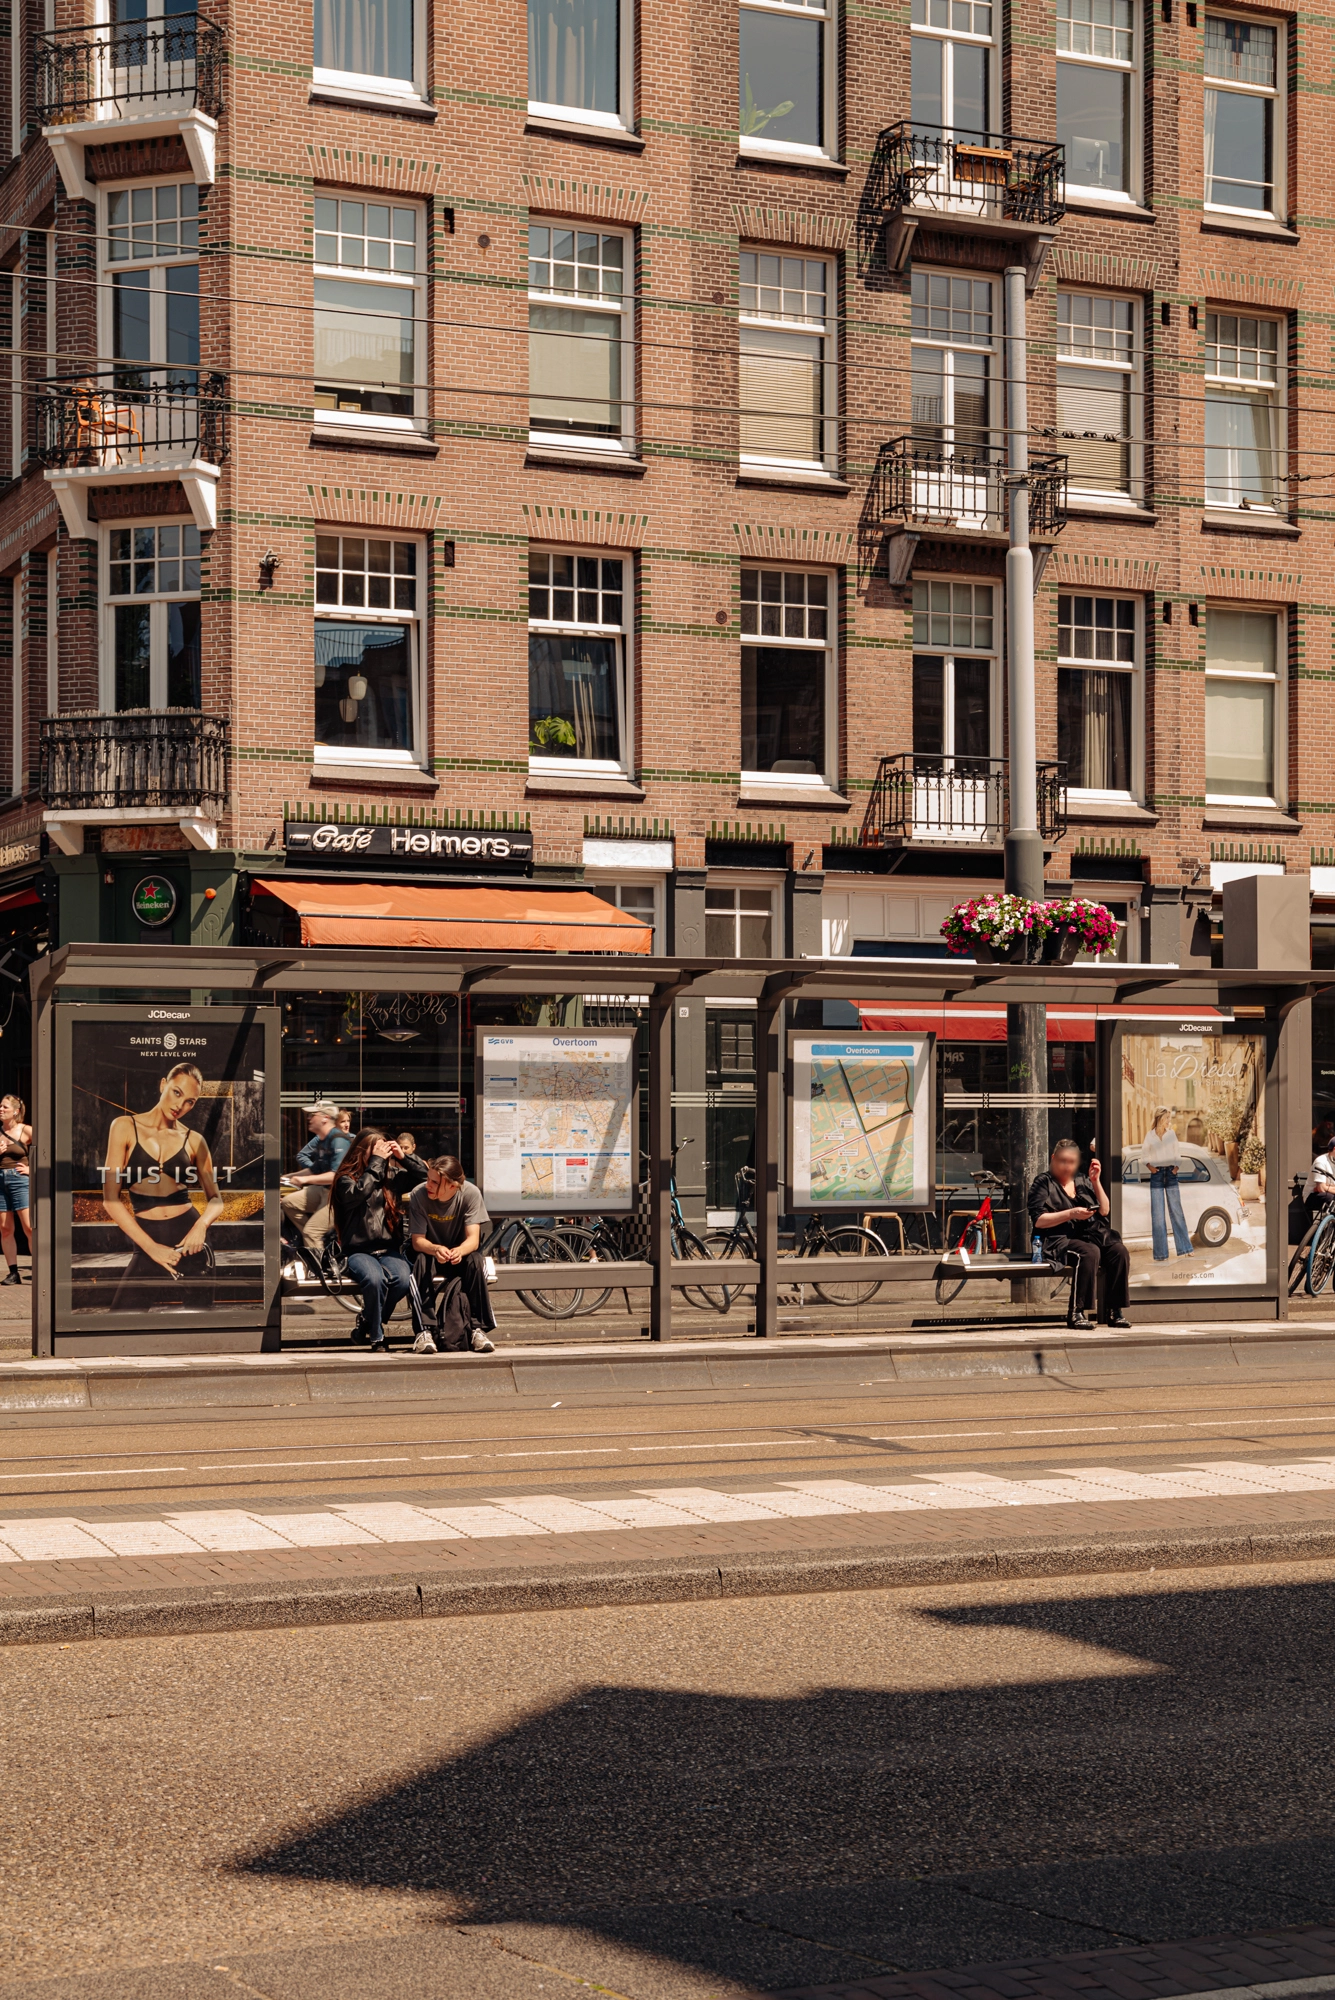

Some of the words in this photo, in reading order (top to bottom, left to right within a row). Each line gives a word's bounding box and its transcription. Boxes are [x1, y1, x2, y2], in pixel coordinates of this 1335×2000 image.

[312, 825, 376, 852] Café
[391, 828, 510, 857] Helmers
[136, 901, 170, 910] Heineken
[1179, 1024, 1213, 1032] JCDecaux
[130, 1037, 162, 1045] SAINTS
[180, 1038, 207, 1046] STARS
[552, 1038, 598, 1046] Overtoom
[944, 1052, 964, 1062] MAS
[1146, 1058, 1166, 1078] La
[1170, 1054, 1240, 1080] Dress
[96, 1166, 161, 1184] THIS
[175, 1166, 198, 1184] IS
[212, 1166, 236, 1184] IT
